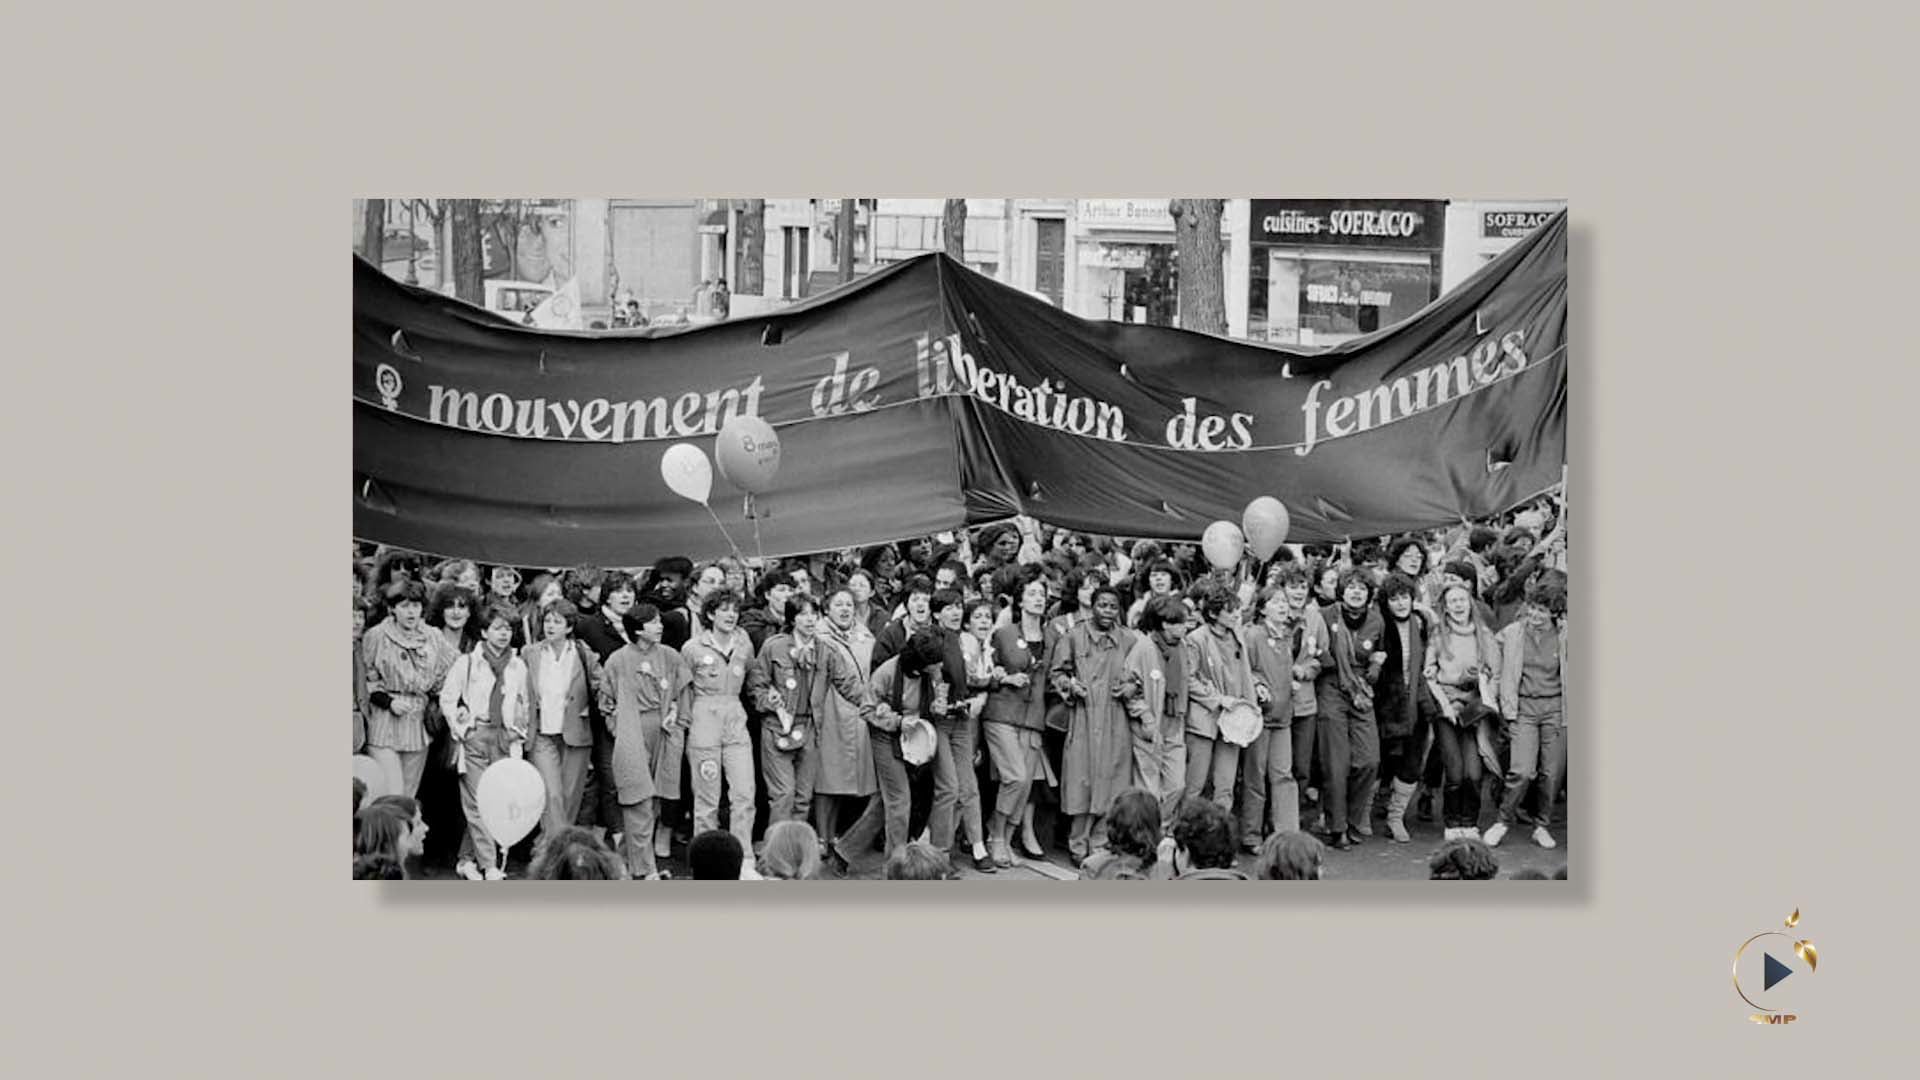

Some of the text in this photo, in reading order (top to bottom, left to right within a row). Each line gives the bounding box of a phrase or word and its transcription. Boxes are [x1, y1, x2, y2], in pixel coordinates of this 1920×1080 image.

[1263, 210, 1415, 237] cuisines SOFRACO
[428, 329, 1529, 456] mouvement de liberation des femmes
